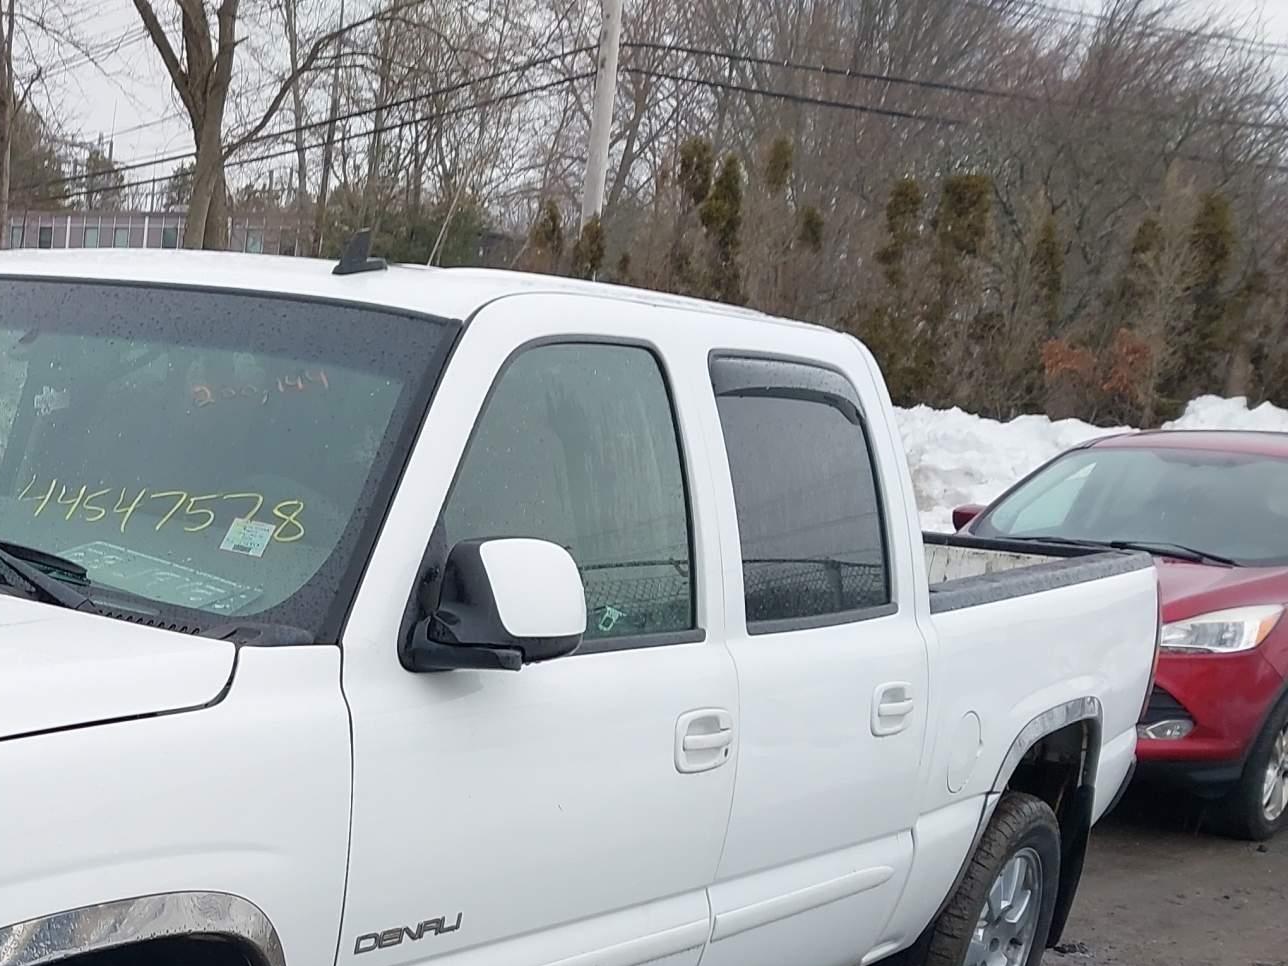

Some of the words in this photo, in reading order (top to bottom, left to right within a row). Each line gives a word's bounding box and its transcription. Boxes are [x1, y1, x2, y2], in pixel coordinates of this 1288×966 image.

[192, 368, 329, 407] 200,144
[18, 475, 306, 543] 44547578
[353, 912, 463, 955] DENALI
